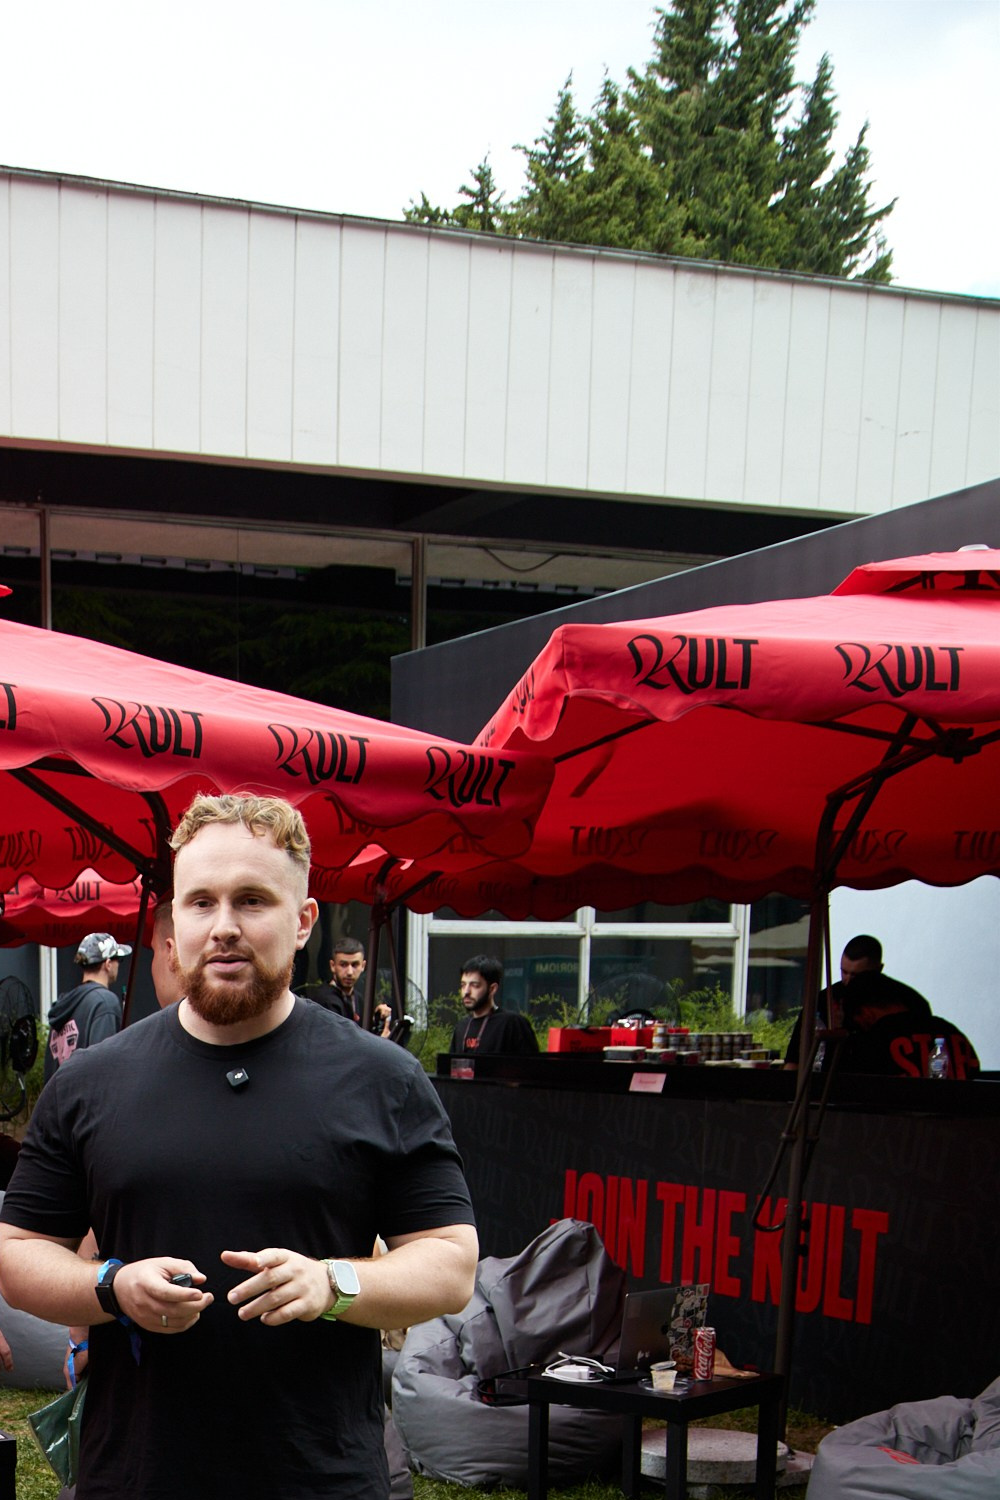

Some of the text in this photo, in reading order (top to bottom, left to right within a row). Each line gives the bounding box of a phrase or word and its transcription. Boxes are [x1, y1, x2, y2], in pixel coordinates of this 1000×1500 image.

[627, 633, 759, 695] KULT
[834, 642, 965, 698] KULT
[91, 696, 204, 759] KULT
[268, 722, 370, 786] KULT
[423, 746, 517, 809] KULT
[549, 1169, 648, 1279] JOIN
[656, 1181, 747, 1299] THE
[752, 1194, 890, 1325] KULT
